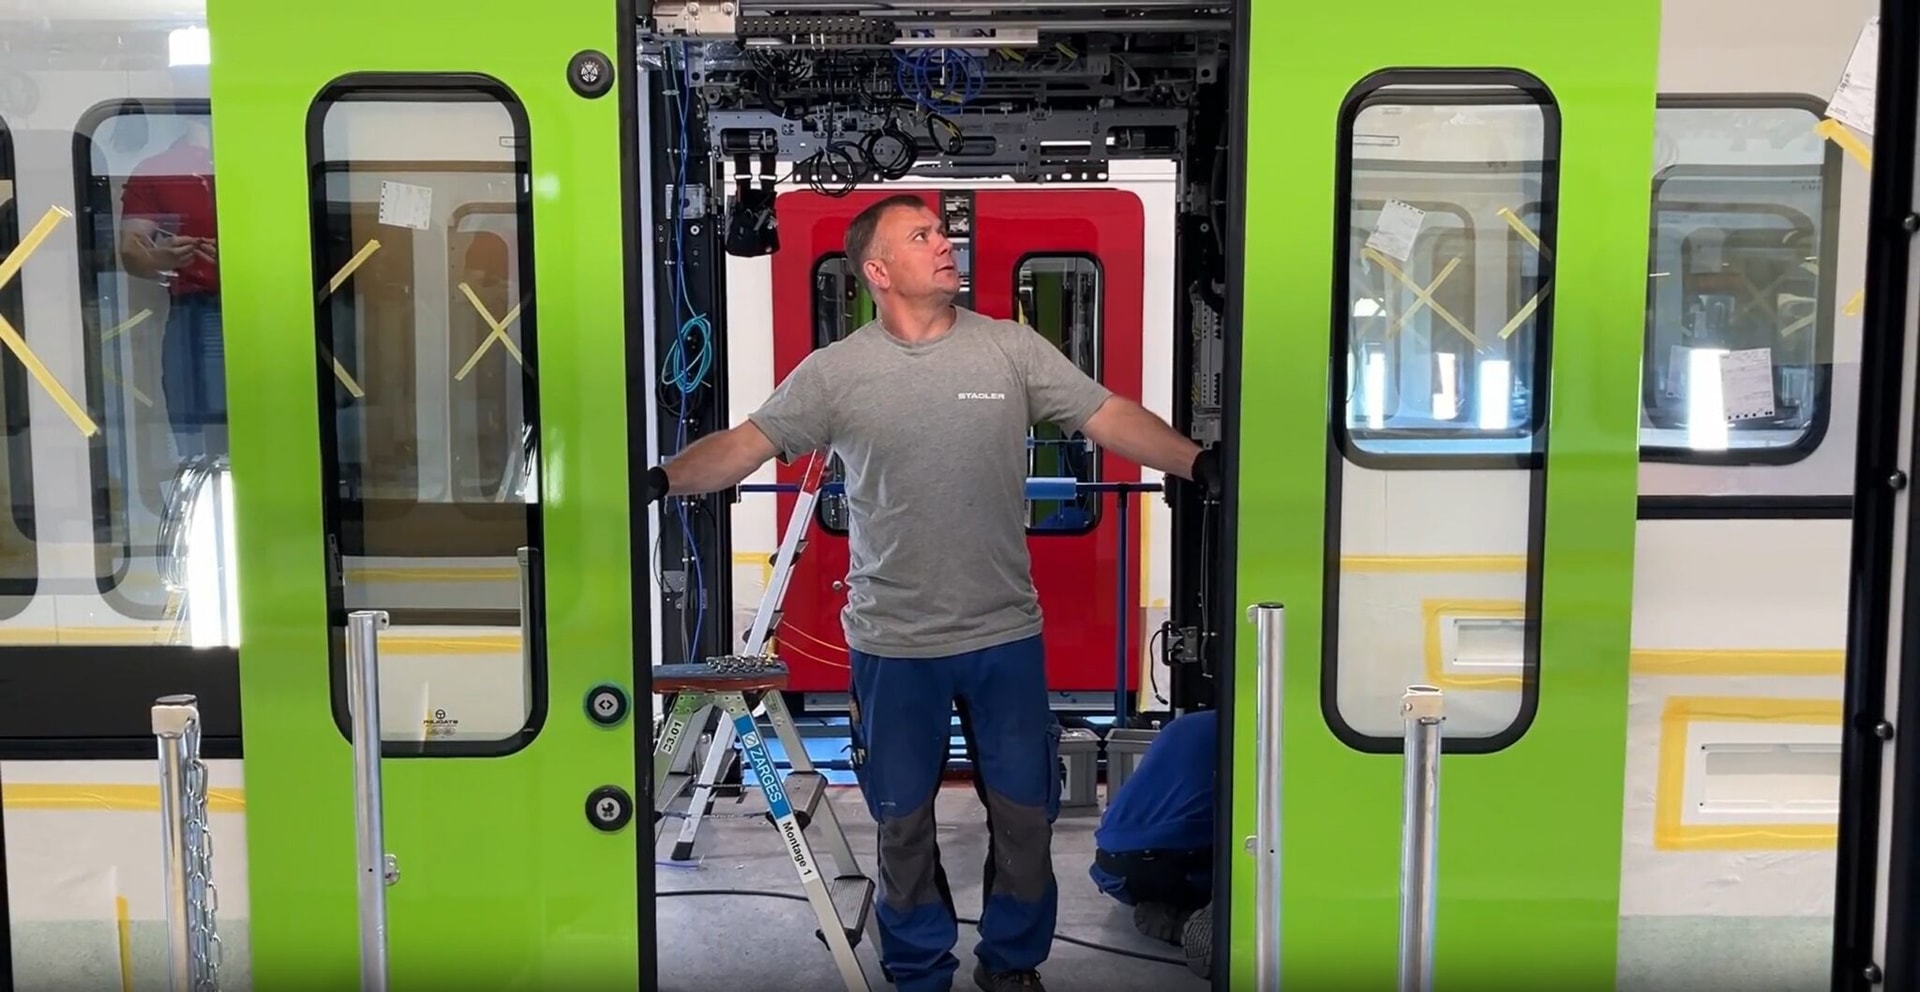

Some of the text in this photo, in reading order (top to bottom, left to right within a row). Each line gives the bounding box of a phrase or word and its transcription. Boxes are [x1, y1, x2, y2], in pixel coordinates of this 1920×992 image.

[958, 392, 1005, 401] STADLER
[750, 747, 782, 803] ZARGES
[782, 821, 807, 868] Montage
